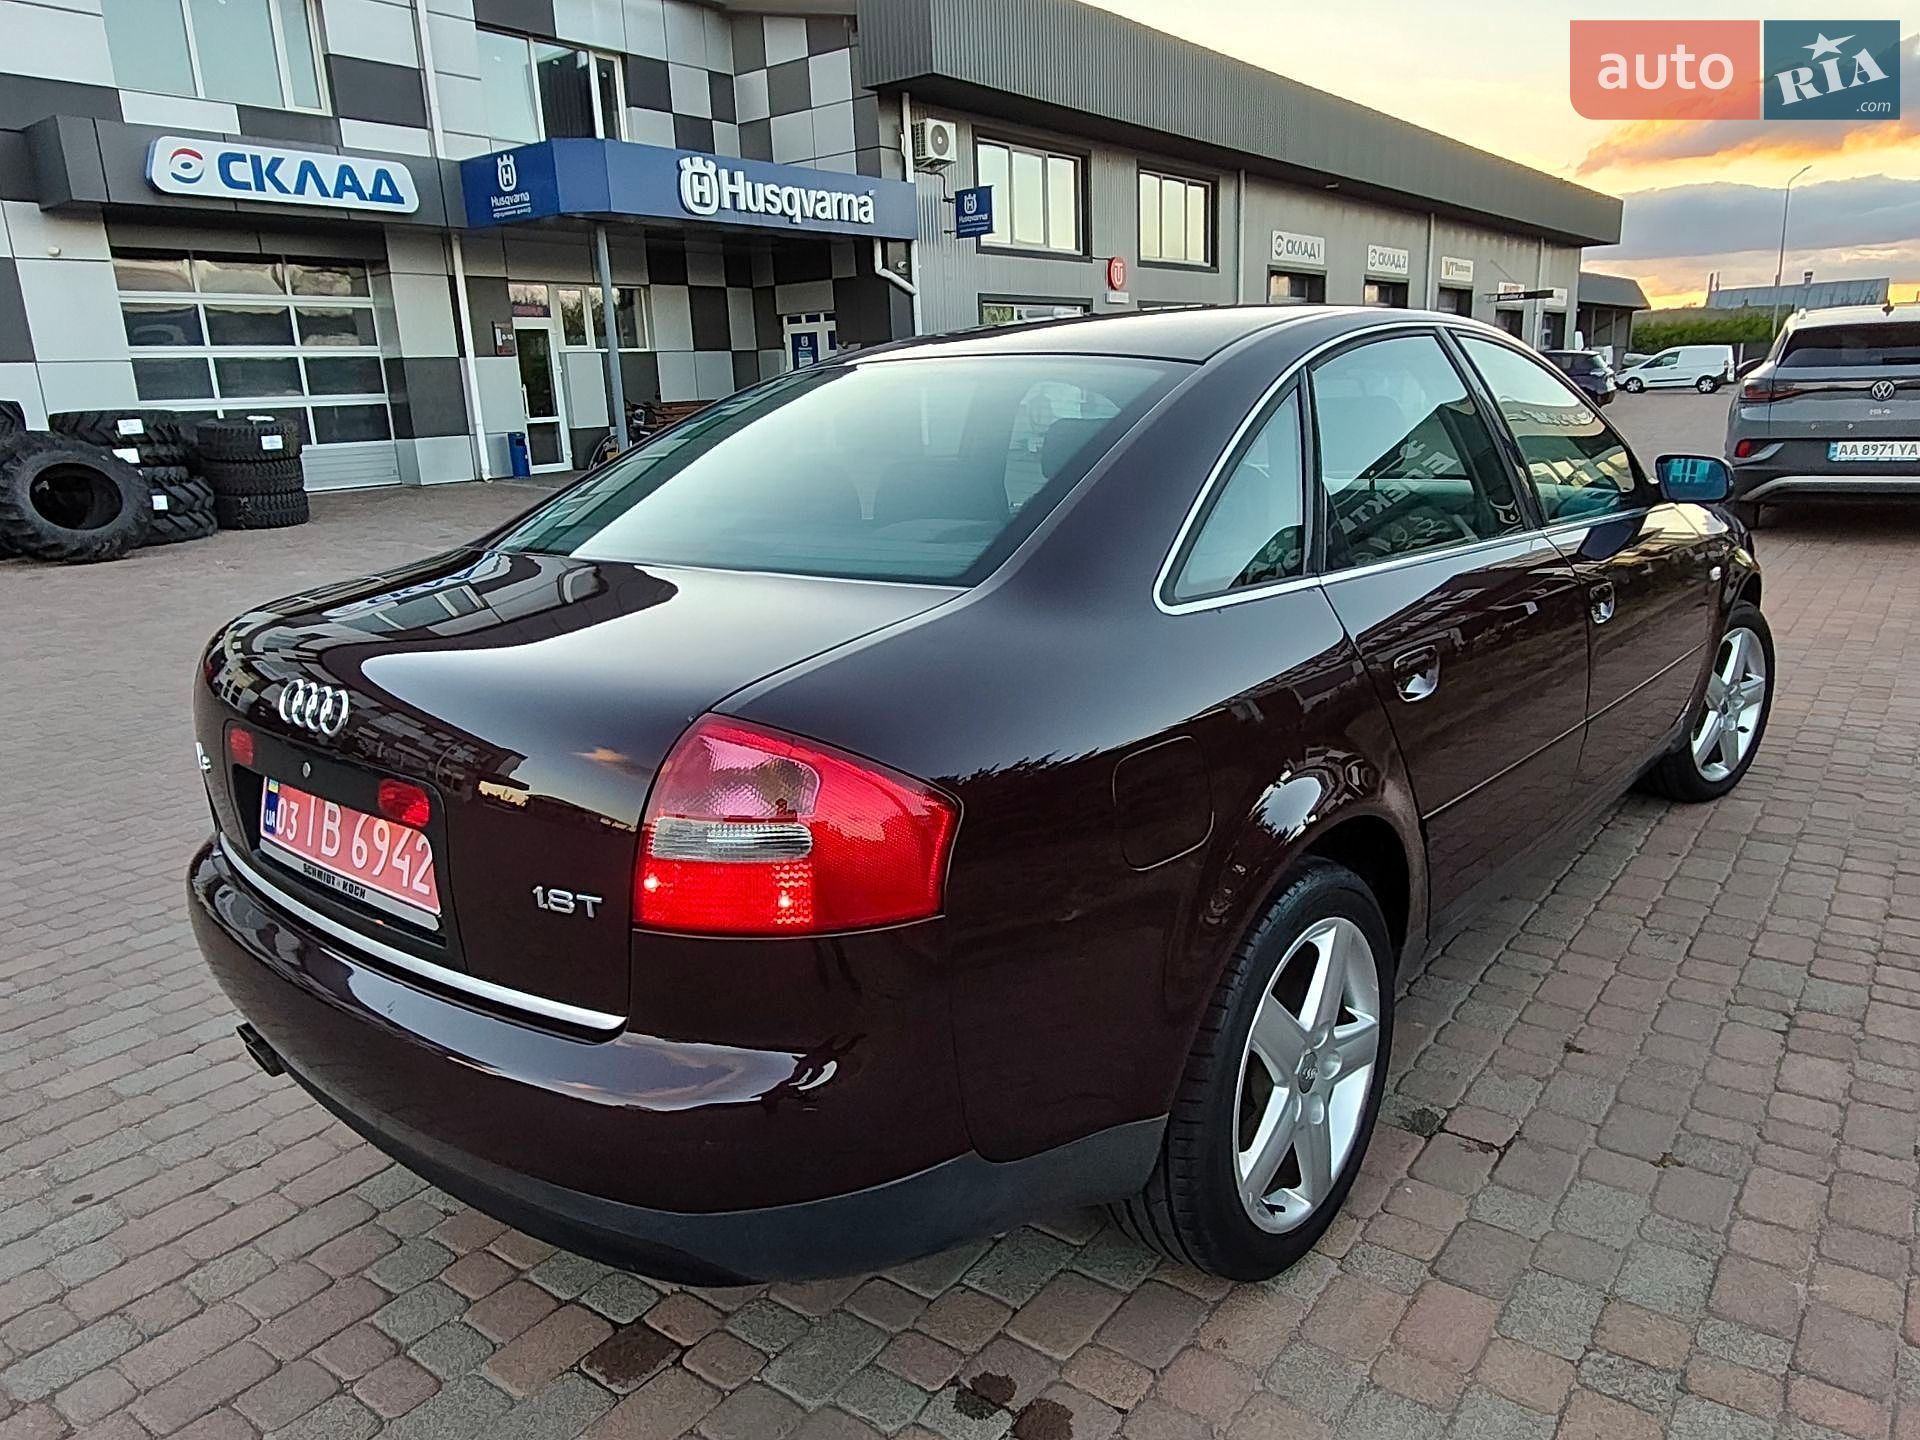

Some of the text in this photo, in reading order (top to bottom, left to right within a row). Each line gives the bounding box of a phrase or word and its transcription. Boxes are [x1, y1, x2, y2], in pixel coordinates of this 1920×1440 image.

[217, 152, 405, 205] СКЛАД
[718, 167, 875, 224] Husqvarna
[490, 191, 530, 207] Husqvarna
[1286, 239, 1316, 260] СКЛАД
[1839, 444, 1858, 456] AA
[1861, 444, 1895, 456] 8971
[1898, 444, 1918, 456] YA
[276, 797, 299, 841] 03
[351, 813, 433, 895] 6942
[303, 863, 367, 900] SCHMIDT KOCH
